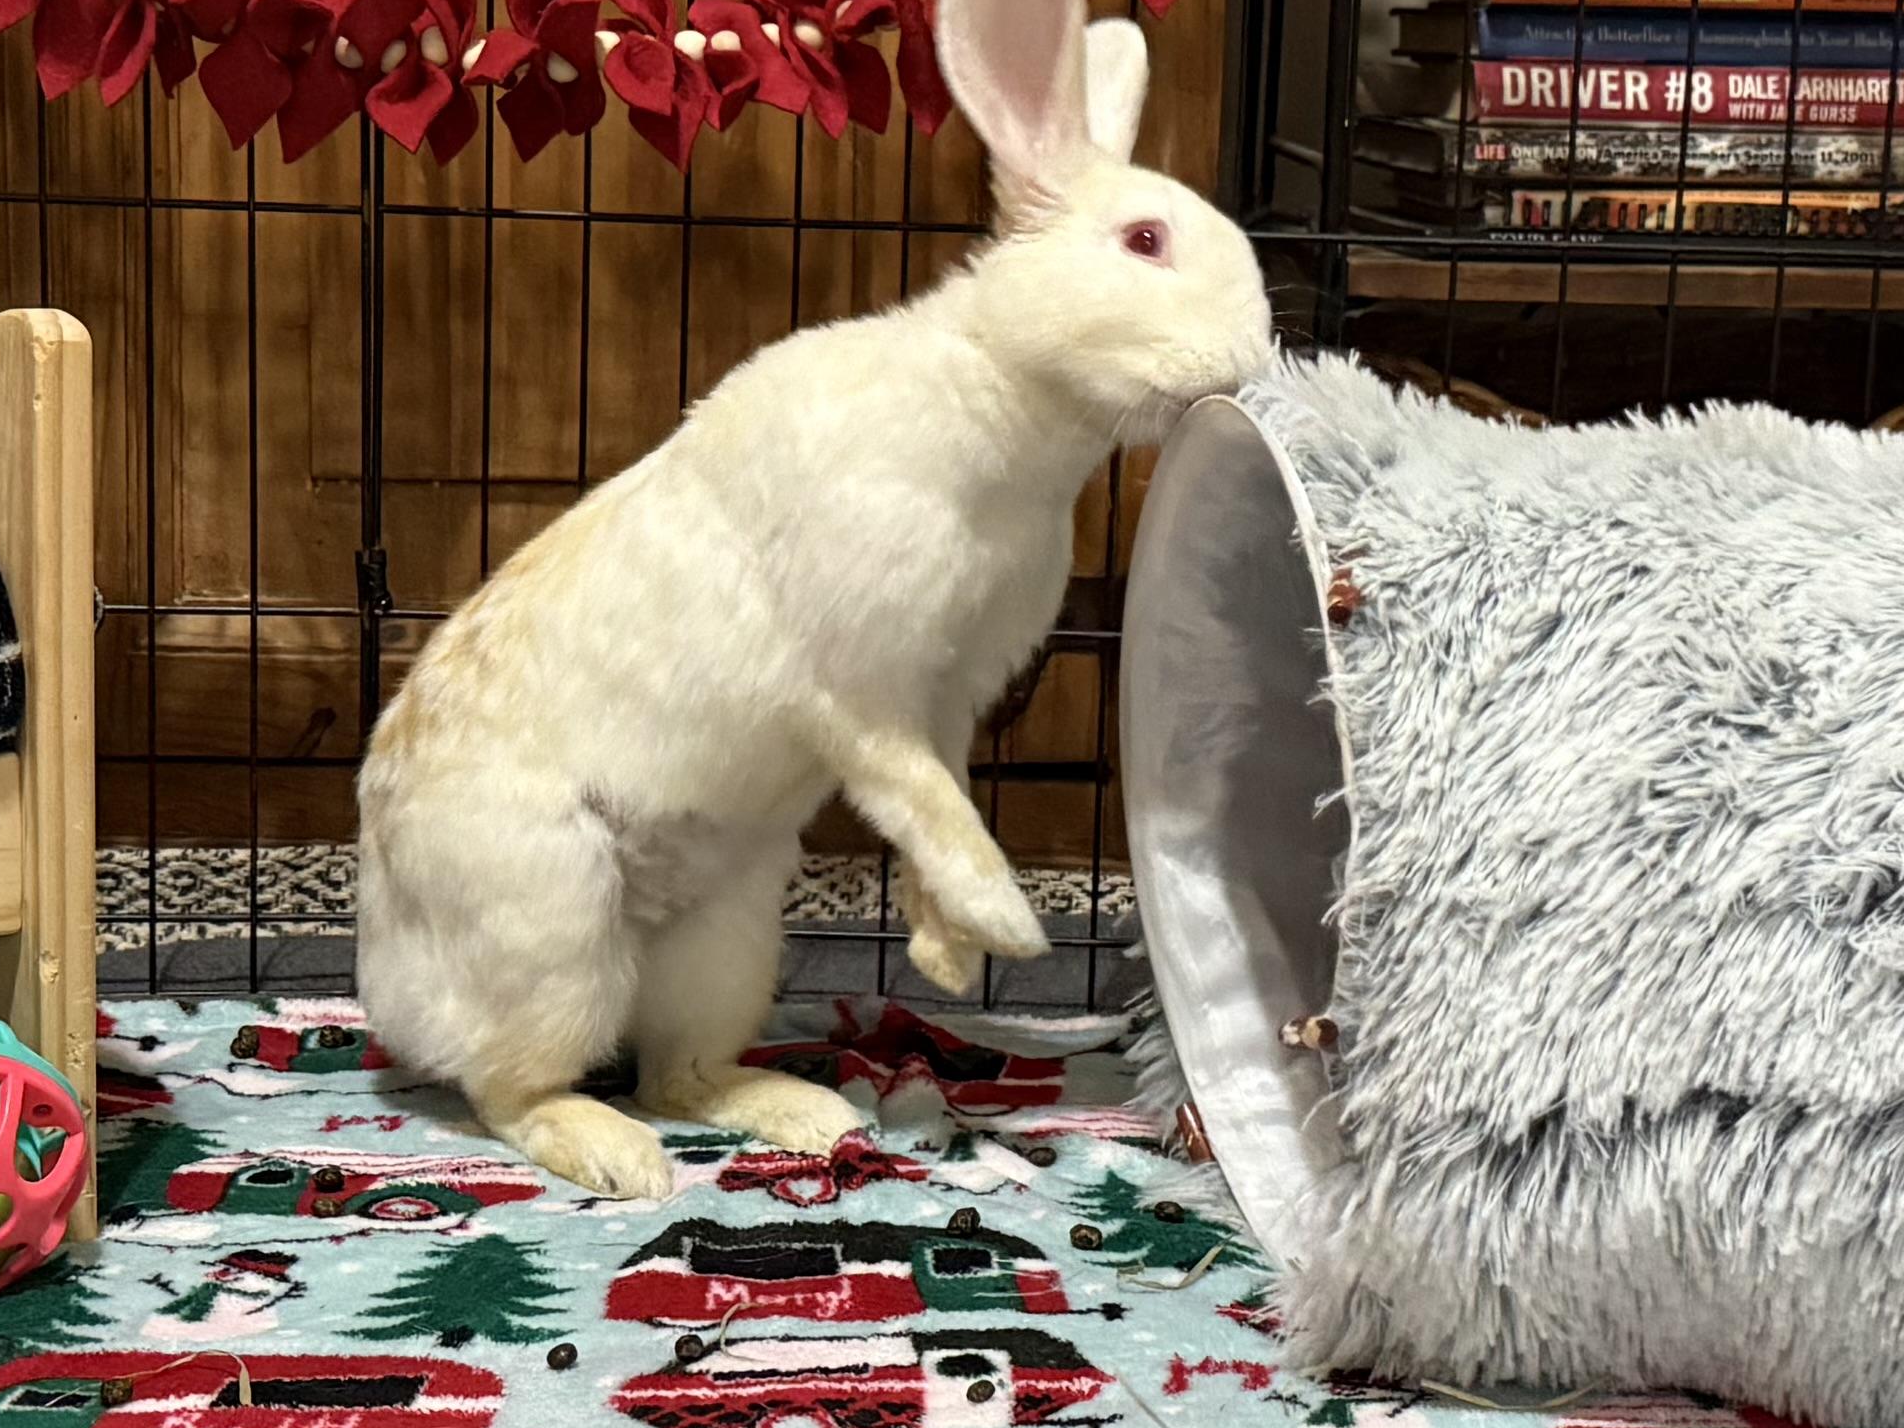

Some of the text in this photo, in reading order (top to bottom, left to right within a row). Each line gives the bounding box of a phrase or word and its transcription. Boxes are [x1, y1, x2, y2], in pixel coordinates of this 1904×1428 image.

[1501, 66, 1650, 112] DRIVER
[1664, 70, 1714, 115] #8
[1728, 74, 1781, 101] DALE
[1728, 102, 1766, 120] WITH
[1769, 103, 1804, 122] JAE
[1474, 144, 1506, 160] LIFE
[1511, 145, 1540, 160] ONE
[1543, 145, 1597, 161] NATON
[1662, 146, 1742, 164] Reembers
[1745, 148, 1817, 167] Septeber
